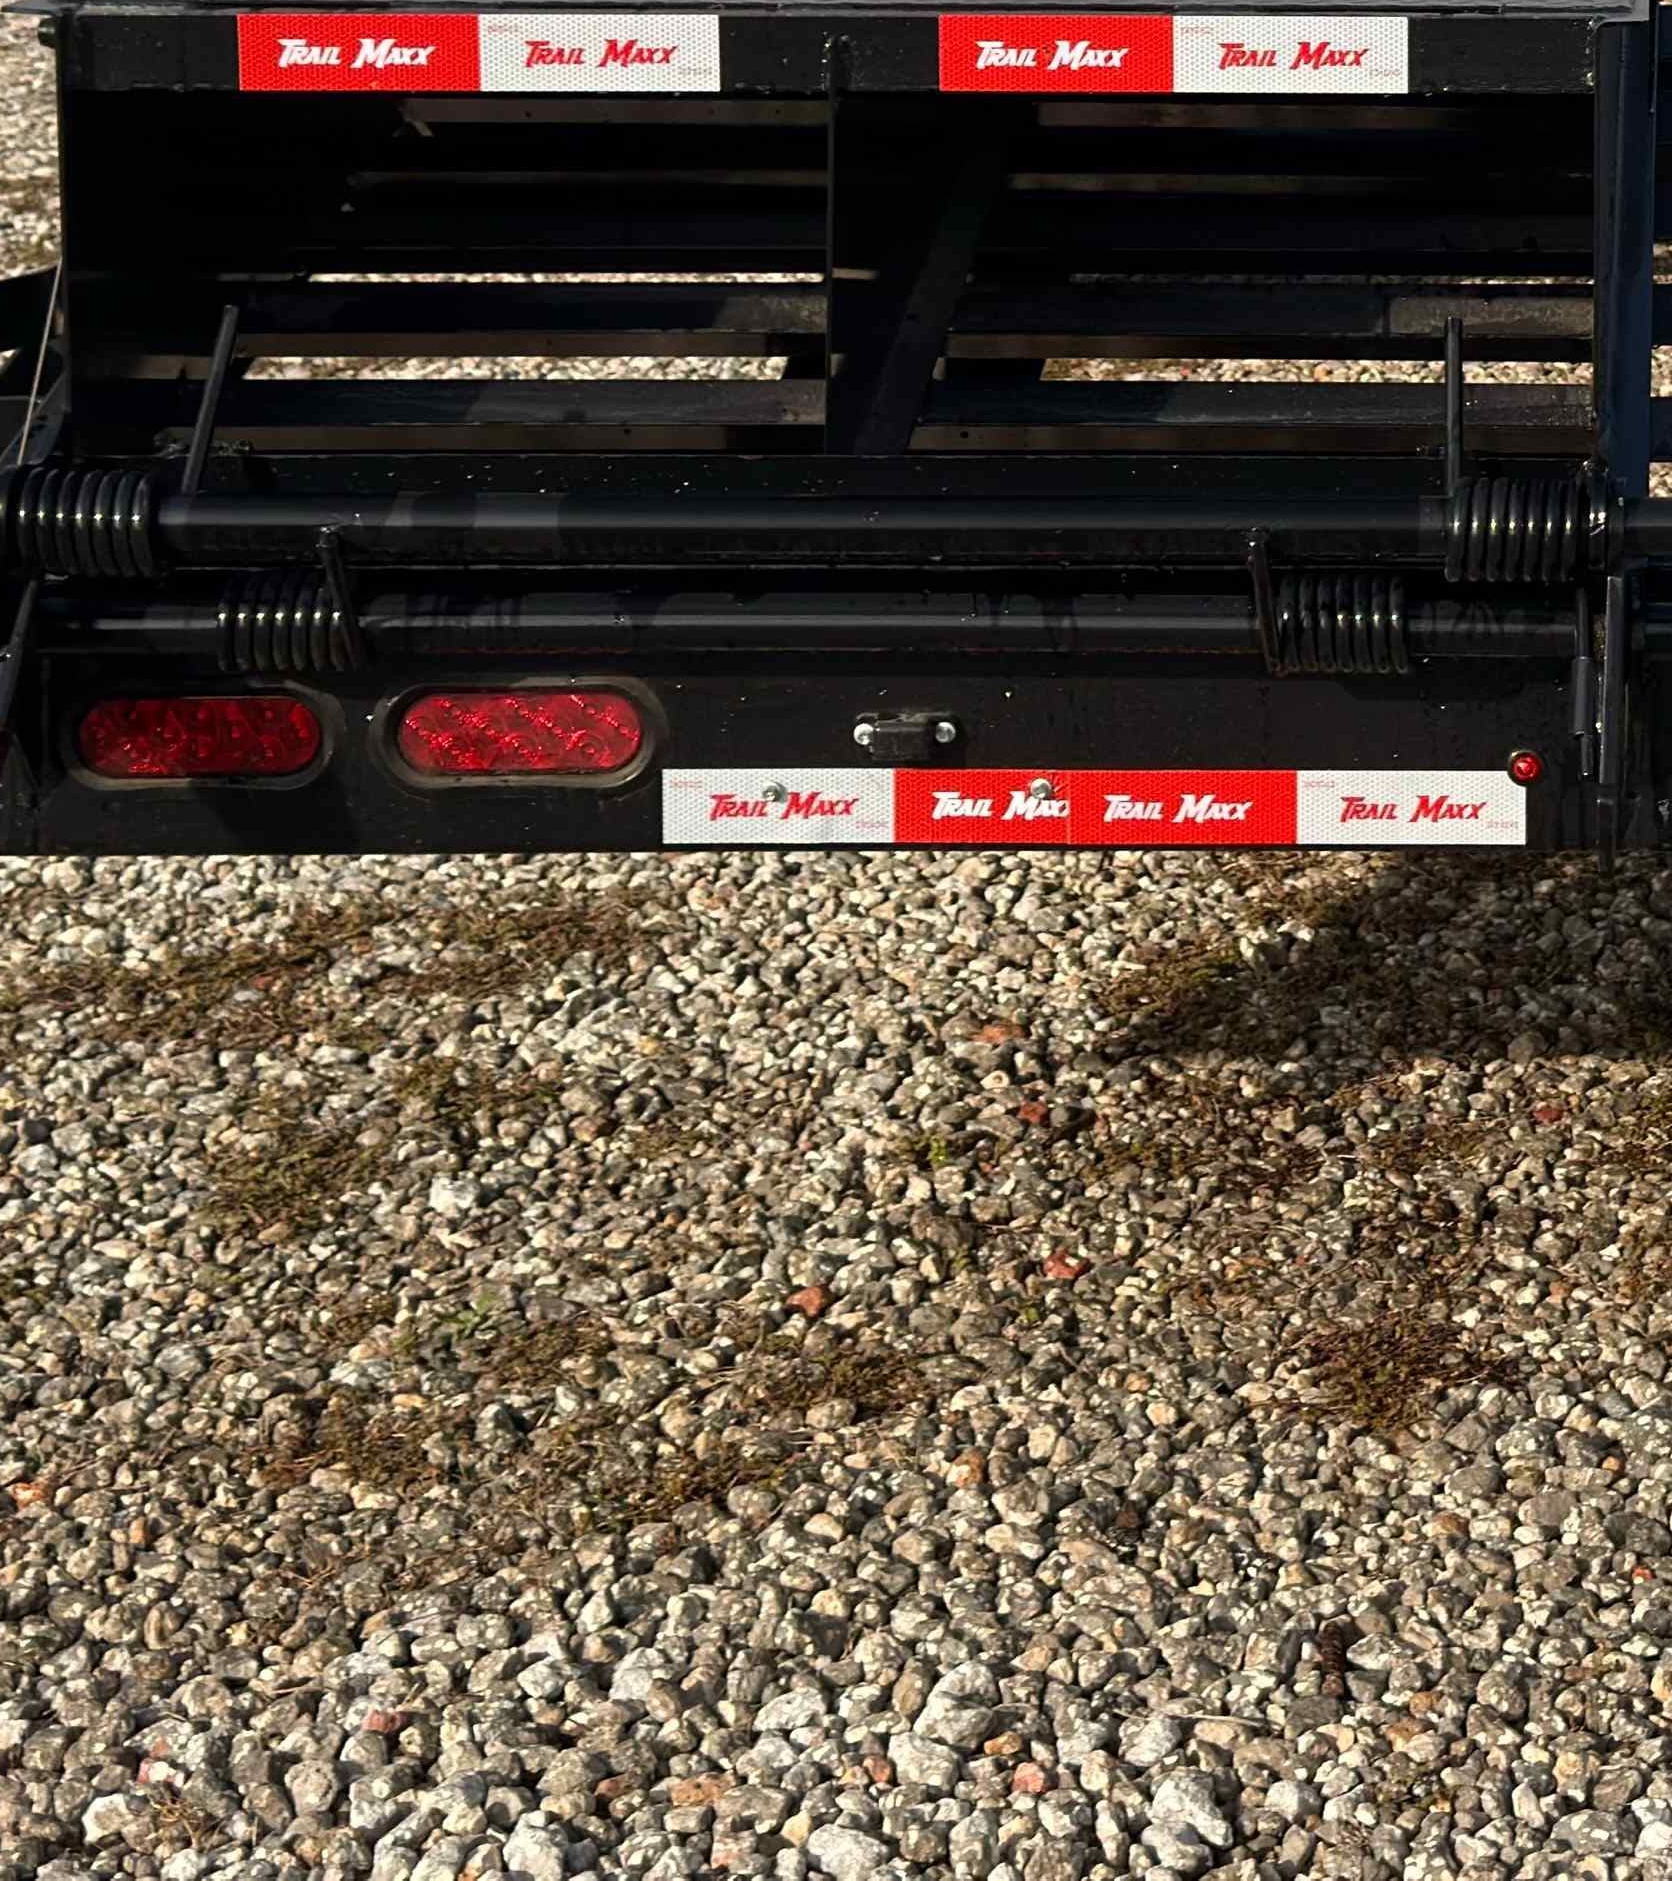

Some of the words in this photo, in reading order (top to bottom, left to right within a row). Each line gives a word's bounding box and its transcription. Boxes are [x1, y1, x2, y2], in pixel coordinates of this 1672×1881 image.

[277, 38, 342, 68] TRAIL
[350, 37, 436, 69] MAXX
[523, 39, 585, 69] TRAIL
[598, 38, 675, 68] MAXX
[975, 40, 1038, 70] TRAIL
[1046, 40, 1130, 71] MAXX
[1219, 42, 1277, 72] TRAIL
[1290, 40, 1368, 70] MAXX
[709, 793, 769, 821] TRAIL
[781, 790, 856, 821] MAXX
[931, 791, 994, 820] TRAIL
[1103, 794, 1164, 823] TRAIL
[1171, 793, 1254, 824] MAXX
[1339, 795, 1398, 824] TRAIL
[1410, 794, 1486, 824] MAXX
